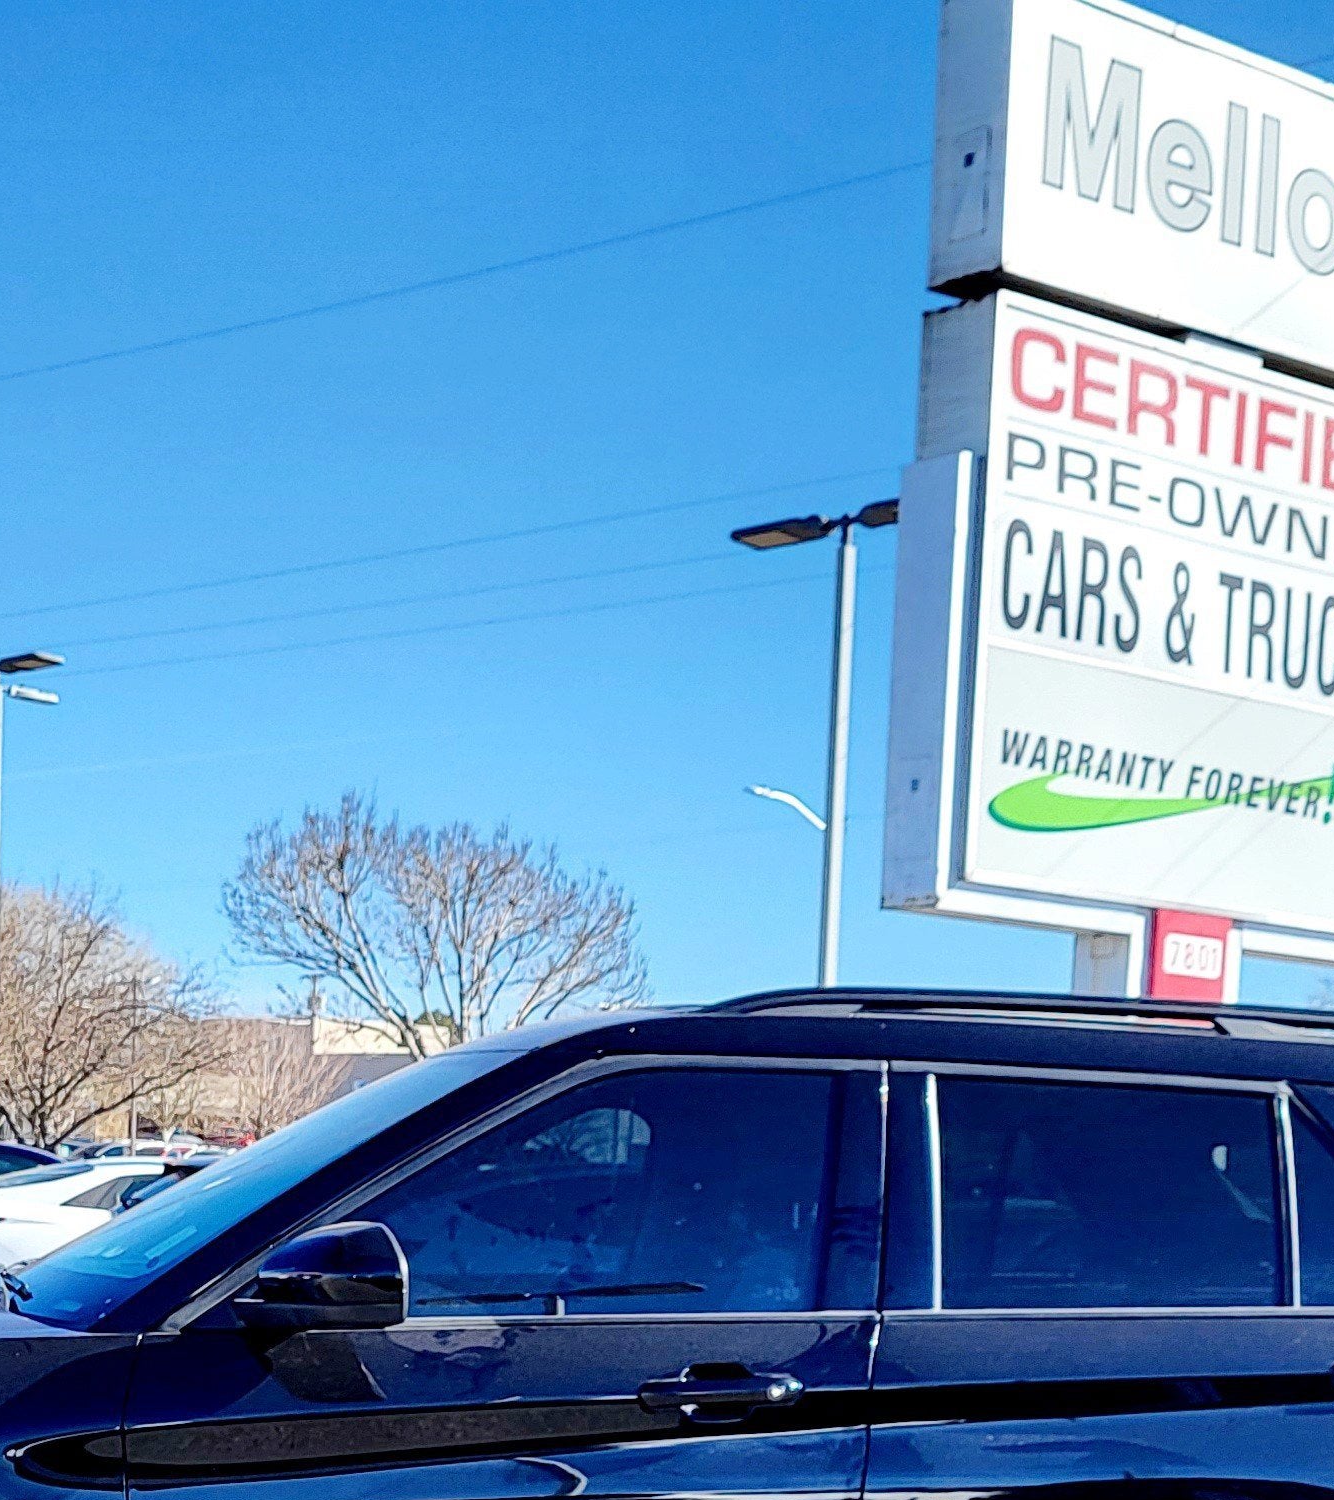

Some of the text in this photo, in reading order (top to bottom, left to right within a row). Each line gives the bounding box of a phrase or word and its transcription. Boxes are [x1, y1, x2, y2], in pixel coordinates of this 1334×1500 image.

[1001, 518, 1144, 654] CARS
[1164, 560, 1195, 666] &
[1000, 728, 1175, 793] WARRANTY
[1170, 940, 1219, 972] 7801
